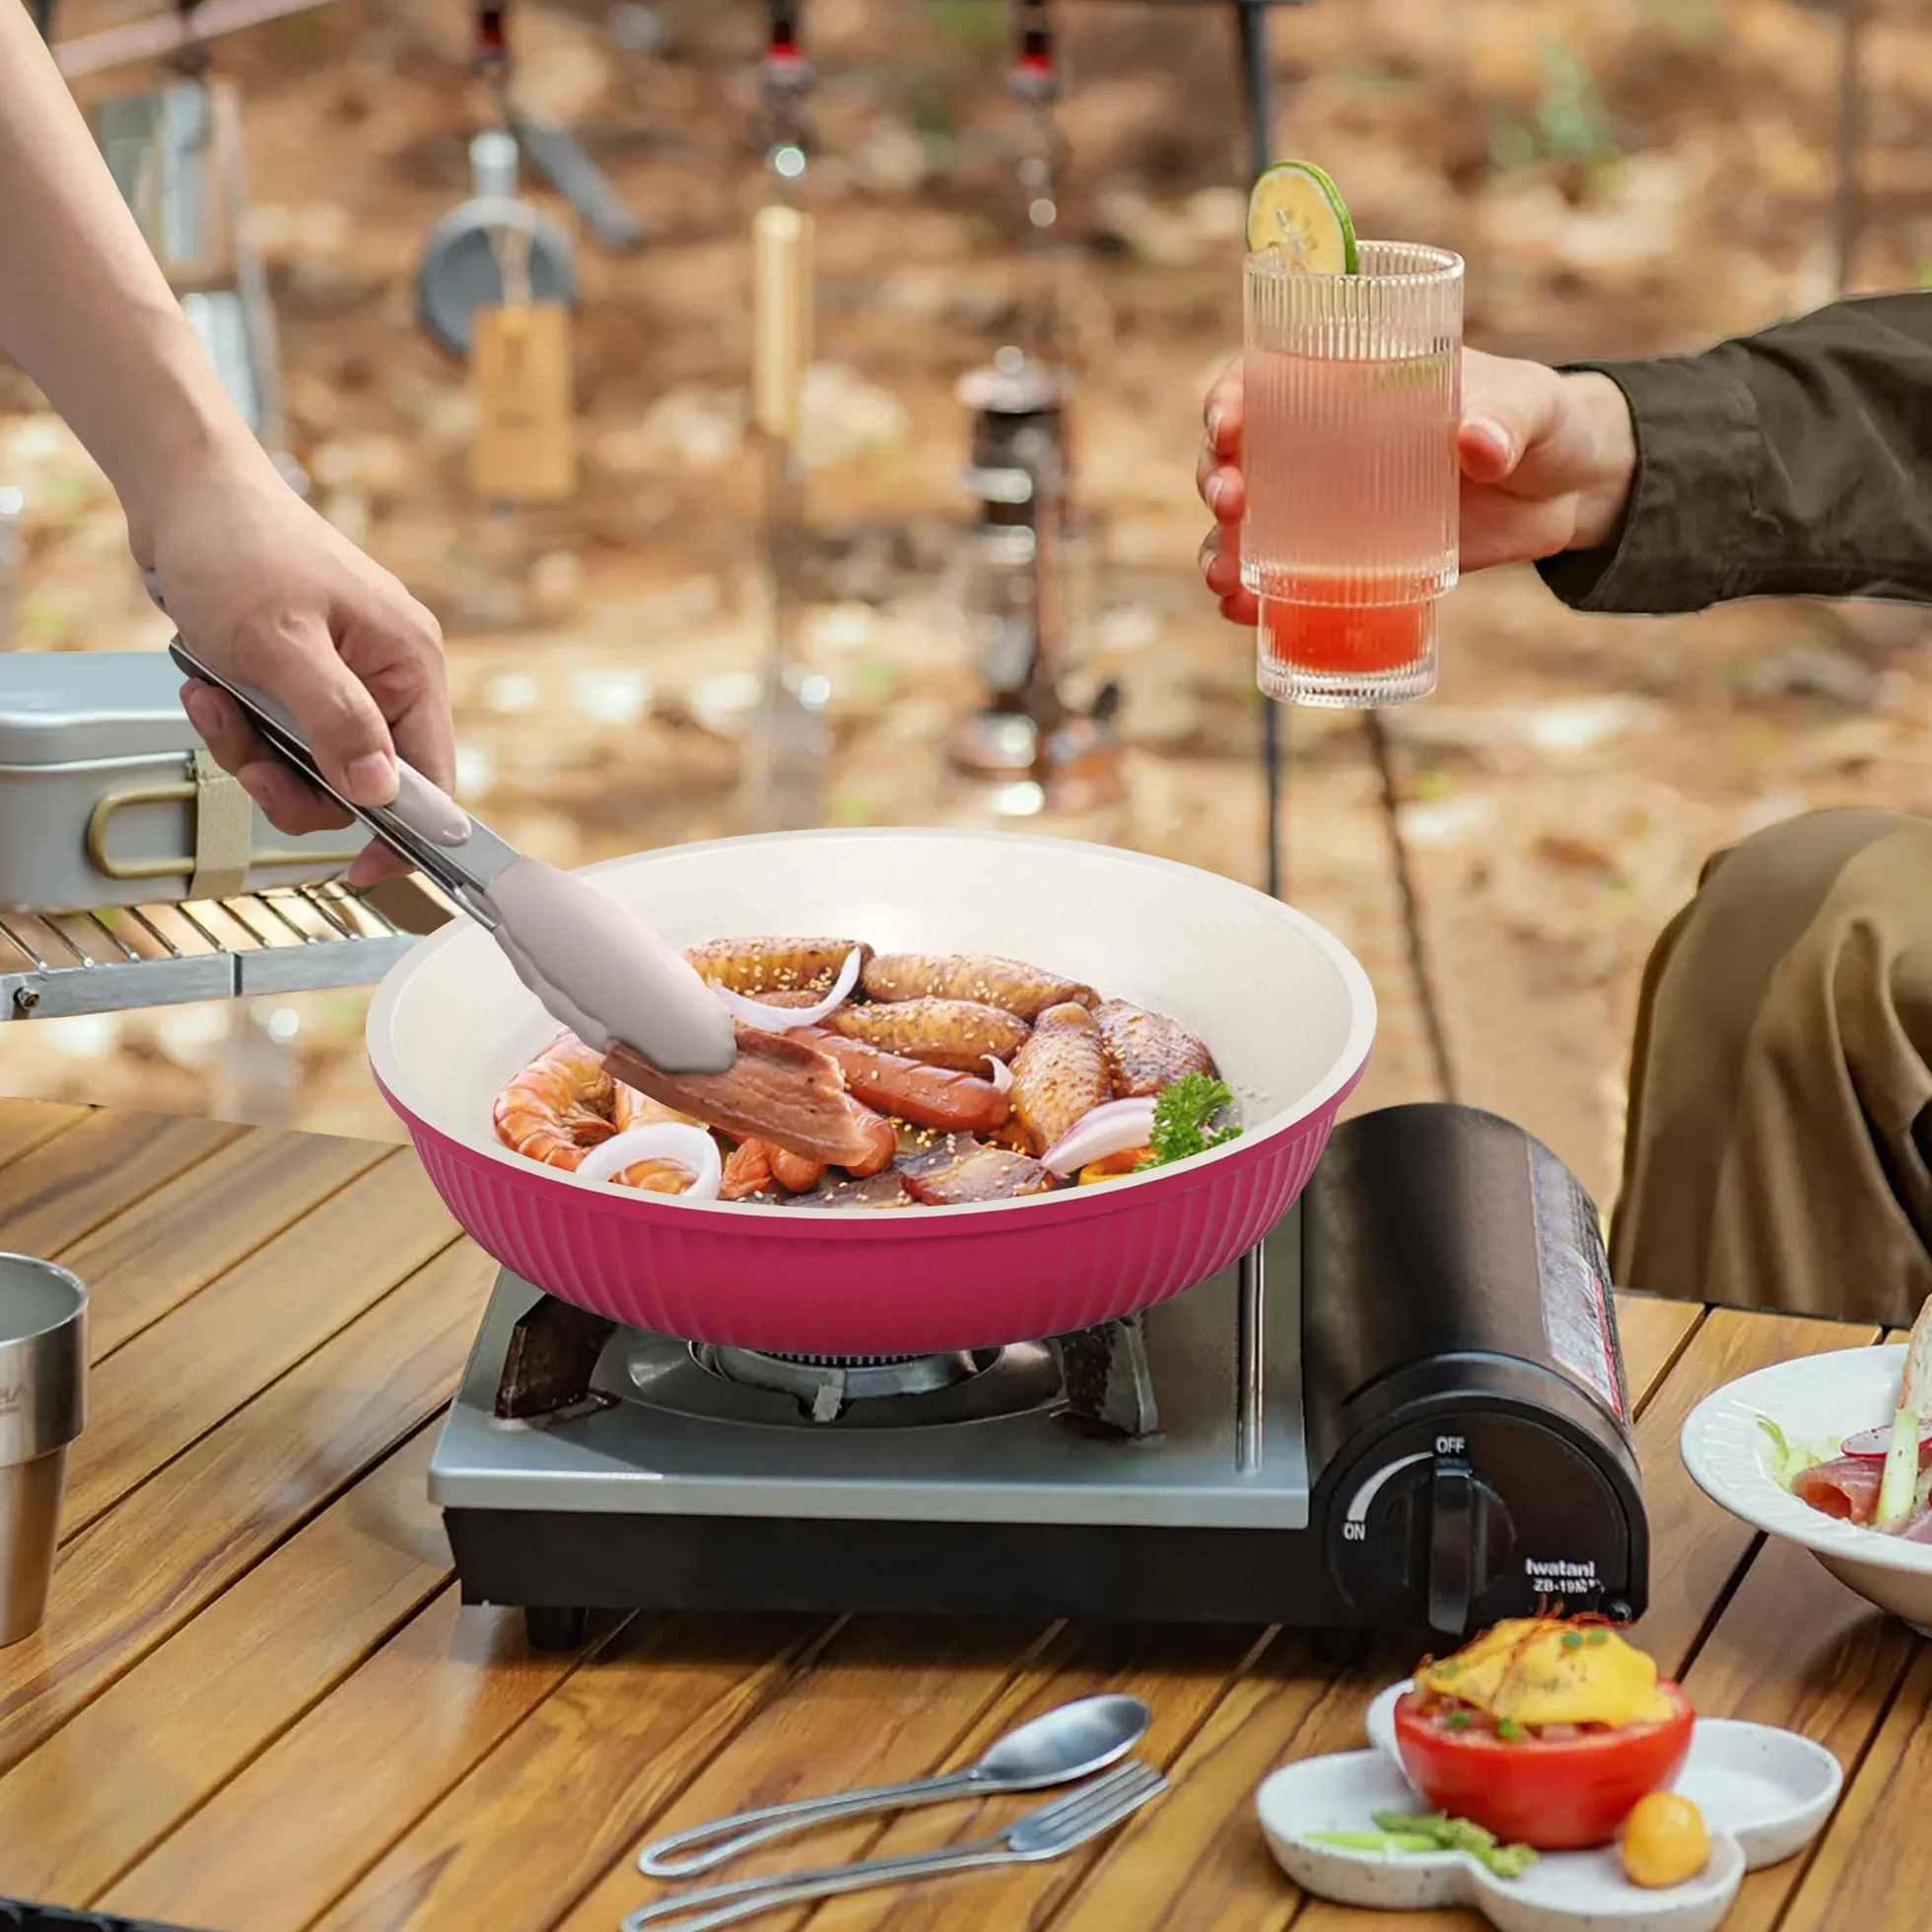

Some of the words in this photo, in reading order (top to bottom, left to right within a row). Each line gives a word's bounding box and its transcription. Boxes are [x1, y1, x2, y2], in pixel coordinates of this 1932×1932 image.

[1436, 1435, 1466, 1454] OFF
[1344, 1522, 1366, 1541] ON
[1525, 1557, 1596, 1577] Iwatani
